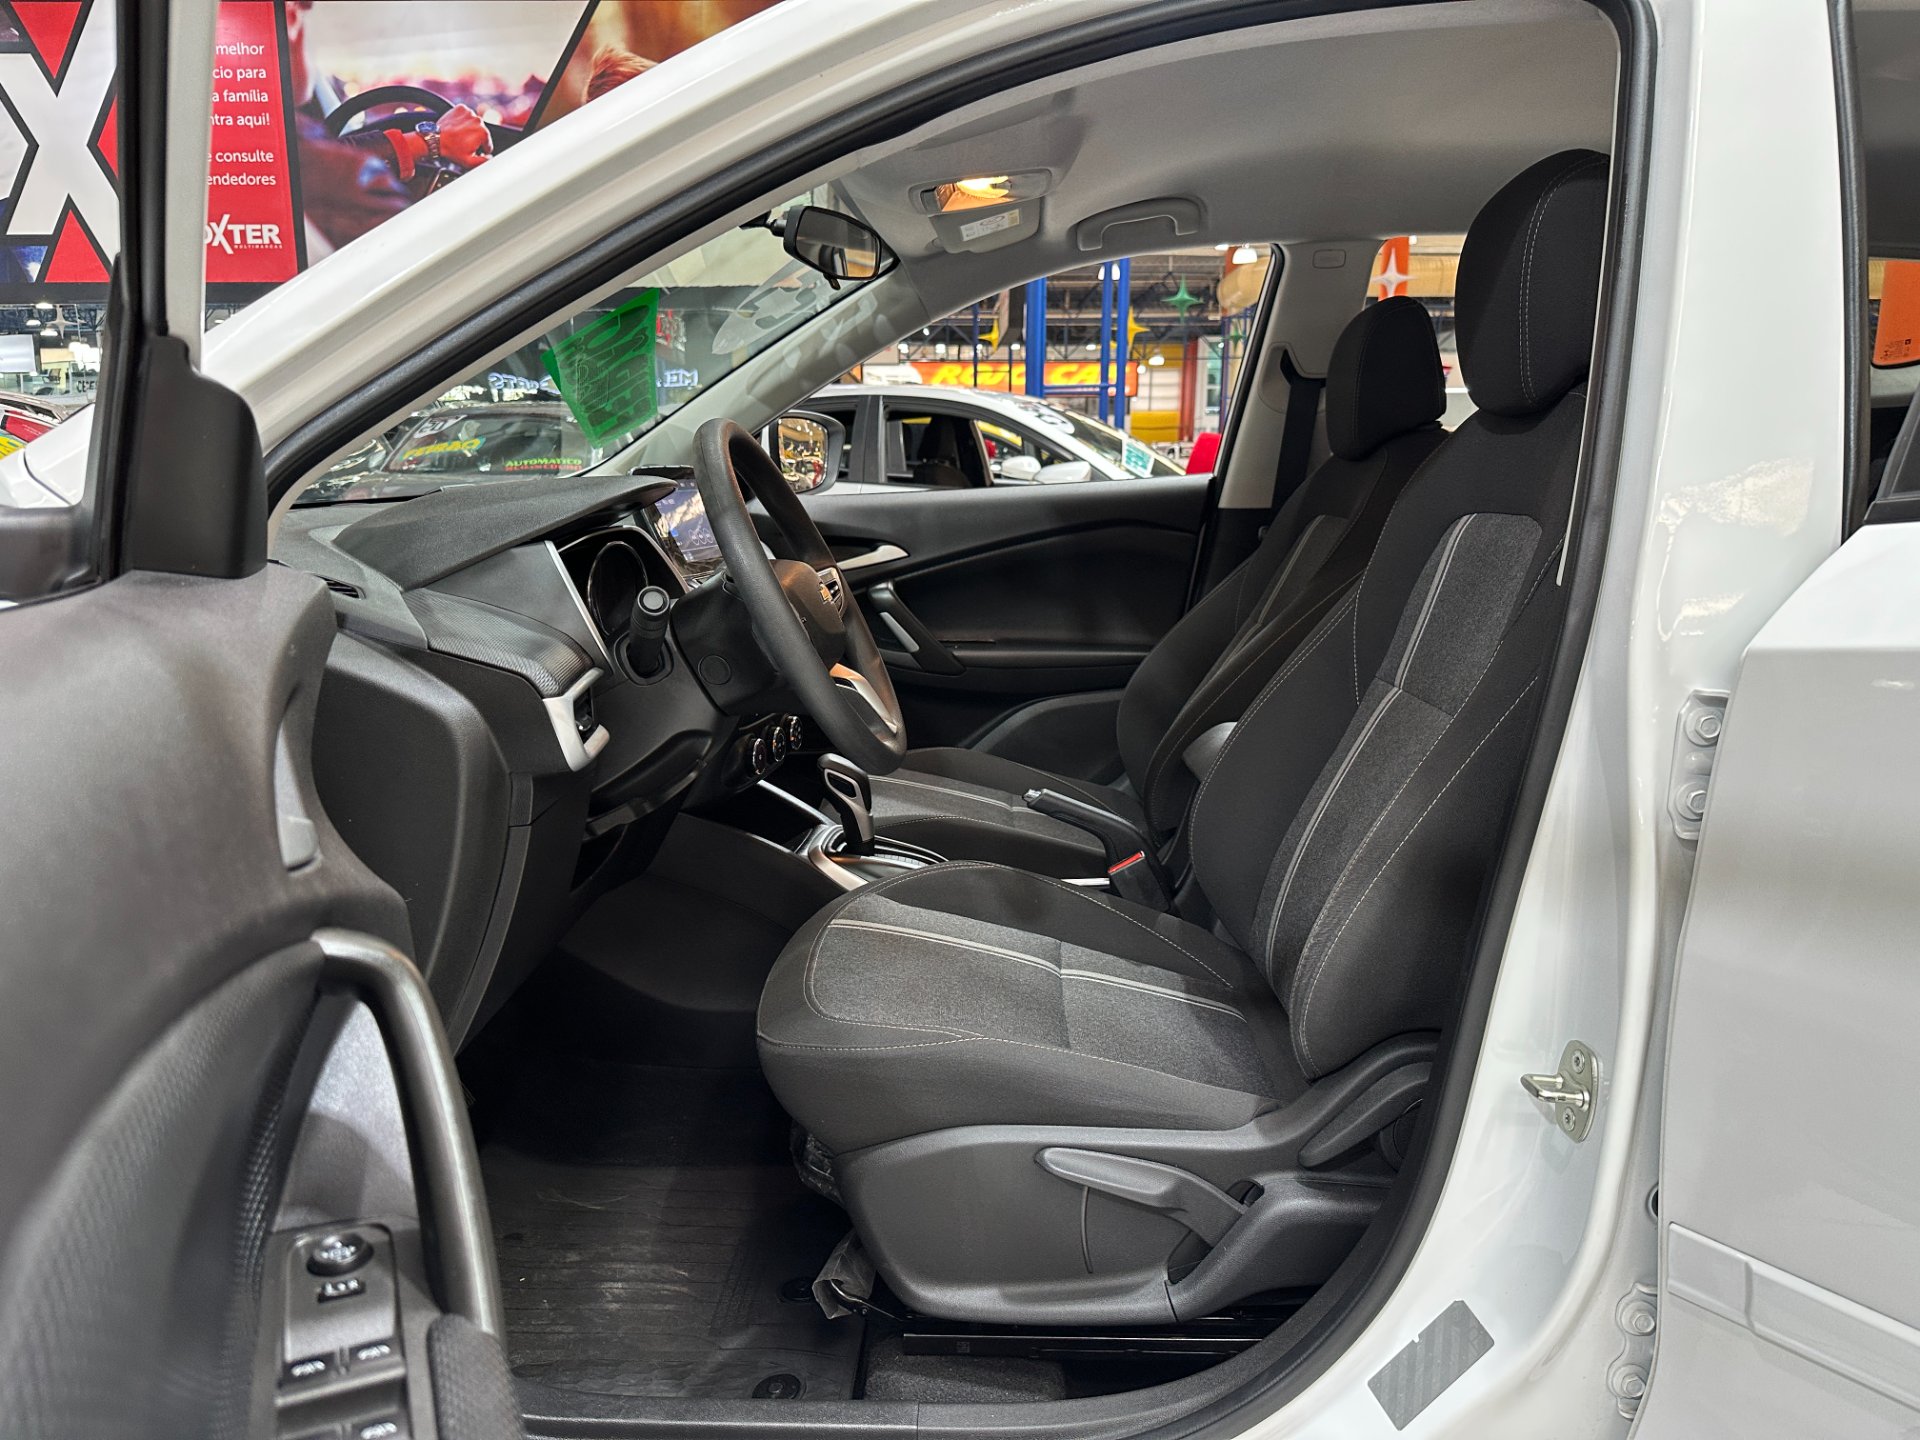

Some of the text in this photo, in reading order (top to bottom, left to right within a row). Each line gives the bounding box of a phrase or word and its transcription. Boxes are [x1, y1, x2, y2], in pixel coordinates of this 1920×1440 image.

[215, 42, 265, 55] melhor
[236, 68, 267, 82] para
[223, 88, 269, 102] família
[236, 112, 270, 129] aqui!
[215, 149, 274, 163] consulte
